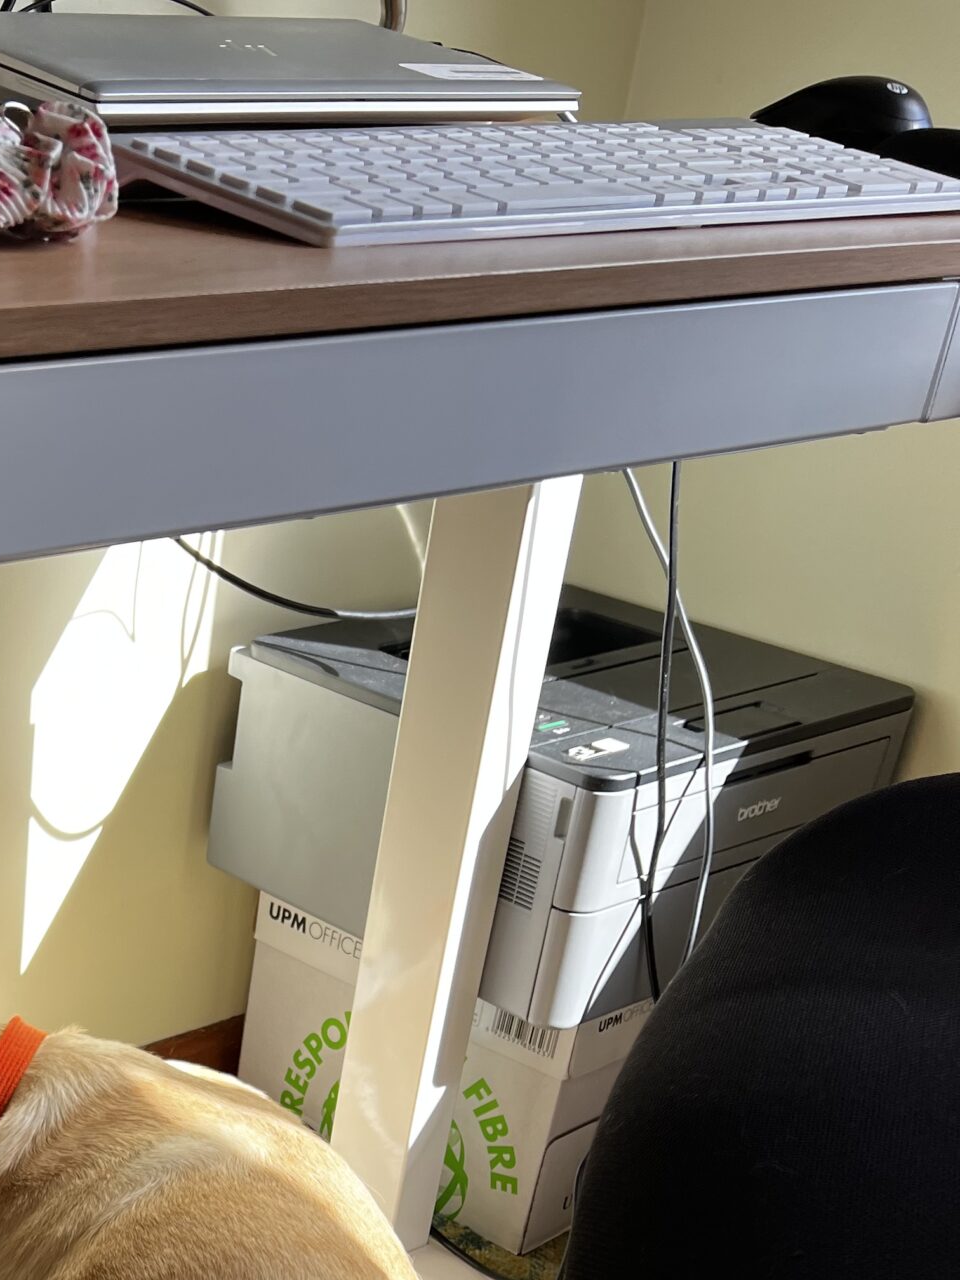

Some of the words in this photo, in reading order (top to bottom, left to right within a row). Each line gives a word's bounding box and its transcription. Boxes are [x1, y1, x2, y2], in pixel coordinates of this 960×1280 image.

[737, 796, 782, 822] brother
[268, 902, 307, 935] UPM
[308, 921, 363, 960] OFFICE
[598, 1012, 623, 1032] UPM
[462, 1077, 518, 1195] FIBRE
